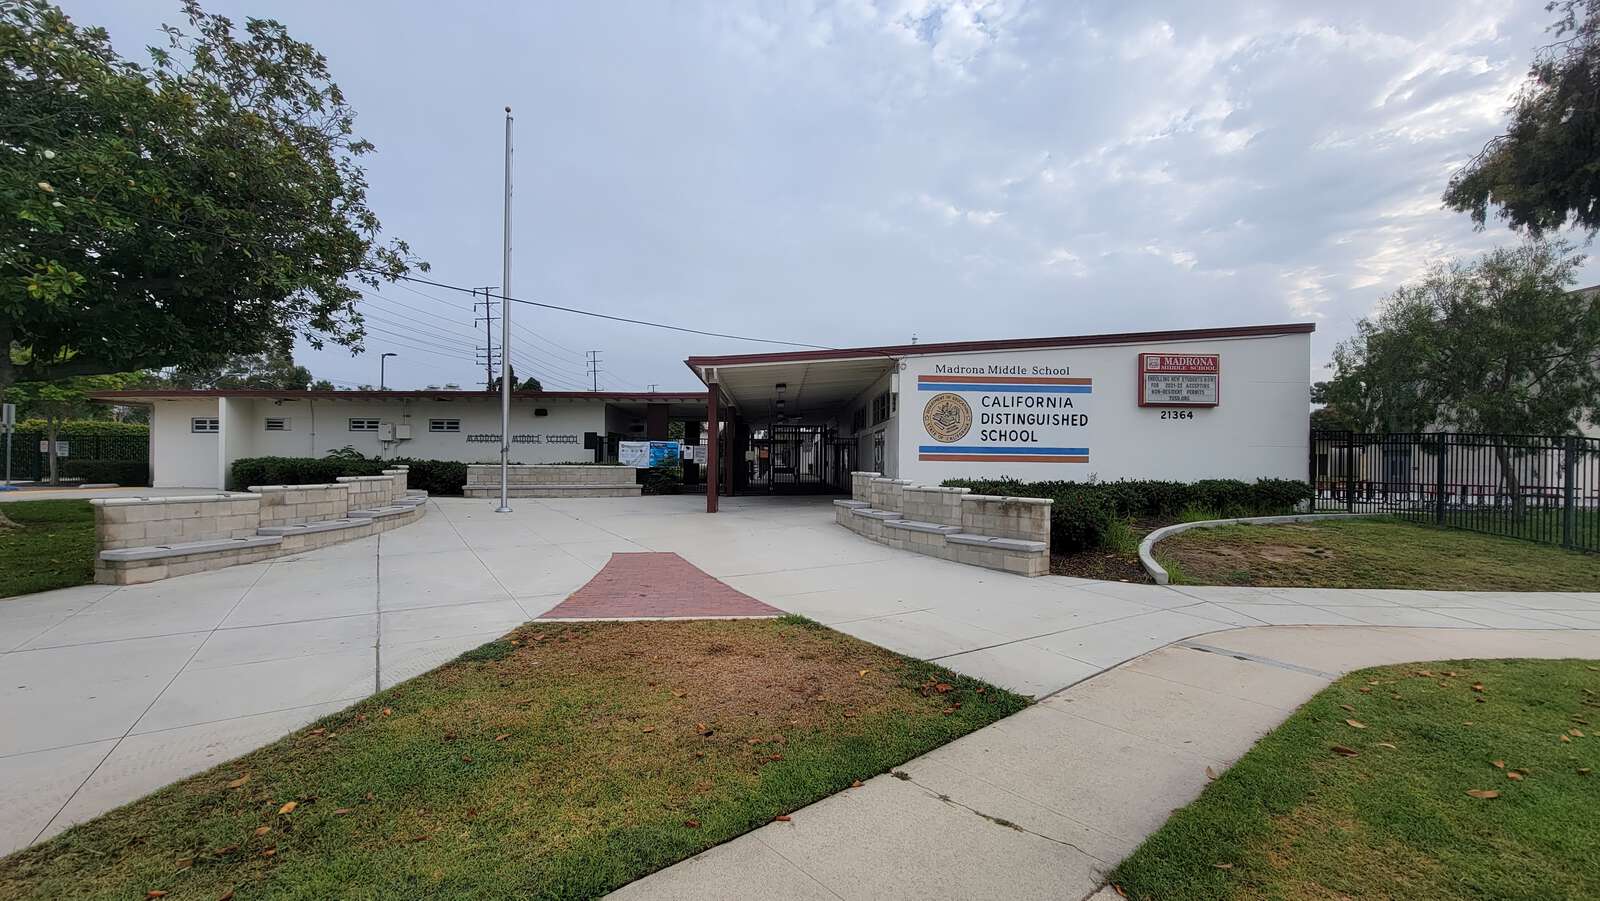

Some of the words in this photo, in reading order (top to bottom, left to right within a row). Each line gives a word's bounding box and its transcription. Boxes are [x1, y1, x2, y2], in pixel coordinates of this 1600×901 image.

[1164, 357, 1214, 366] MADRONA
[935, 364, 985, 375] Madrona
[988, 364, 1027, 375] Middle
[1032, 365, 1070, 376] School
[981, 395, 1074, 409] CALIFORNIA
[981, 413, 1089, 427] DISTINGUISHED
[1160, 410, 1194, 420] 21364
[466, 434, 505, 443] MADRON
[512, 434, 542, 444] MIDDLE
[546, 434, 580, 444] SCHOOL
[980, 430, 1039, 443] SCHOOL
